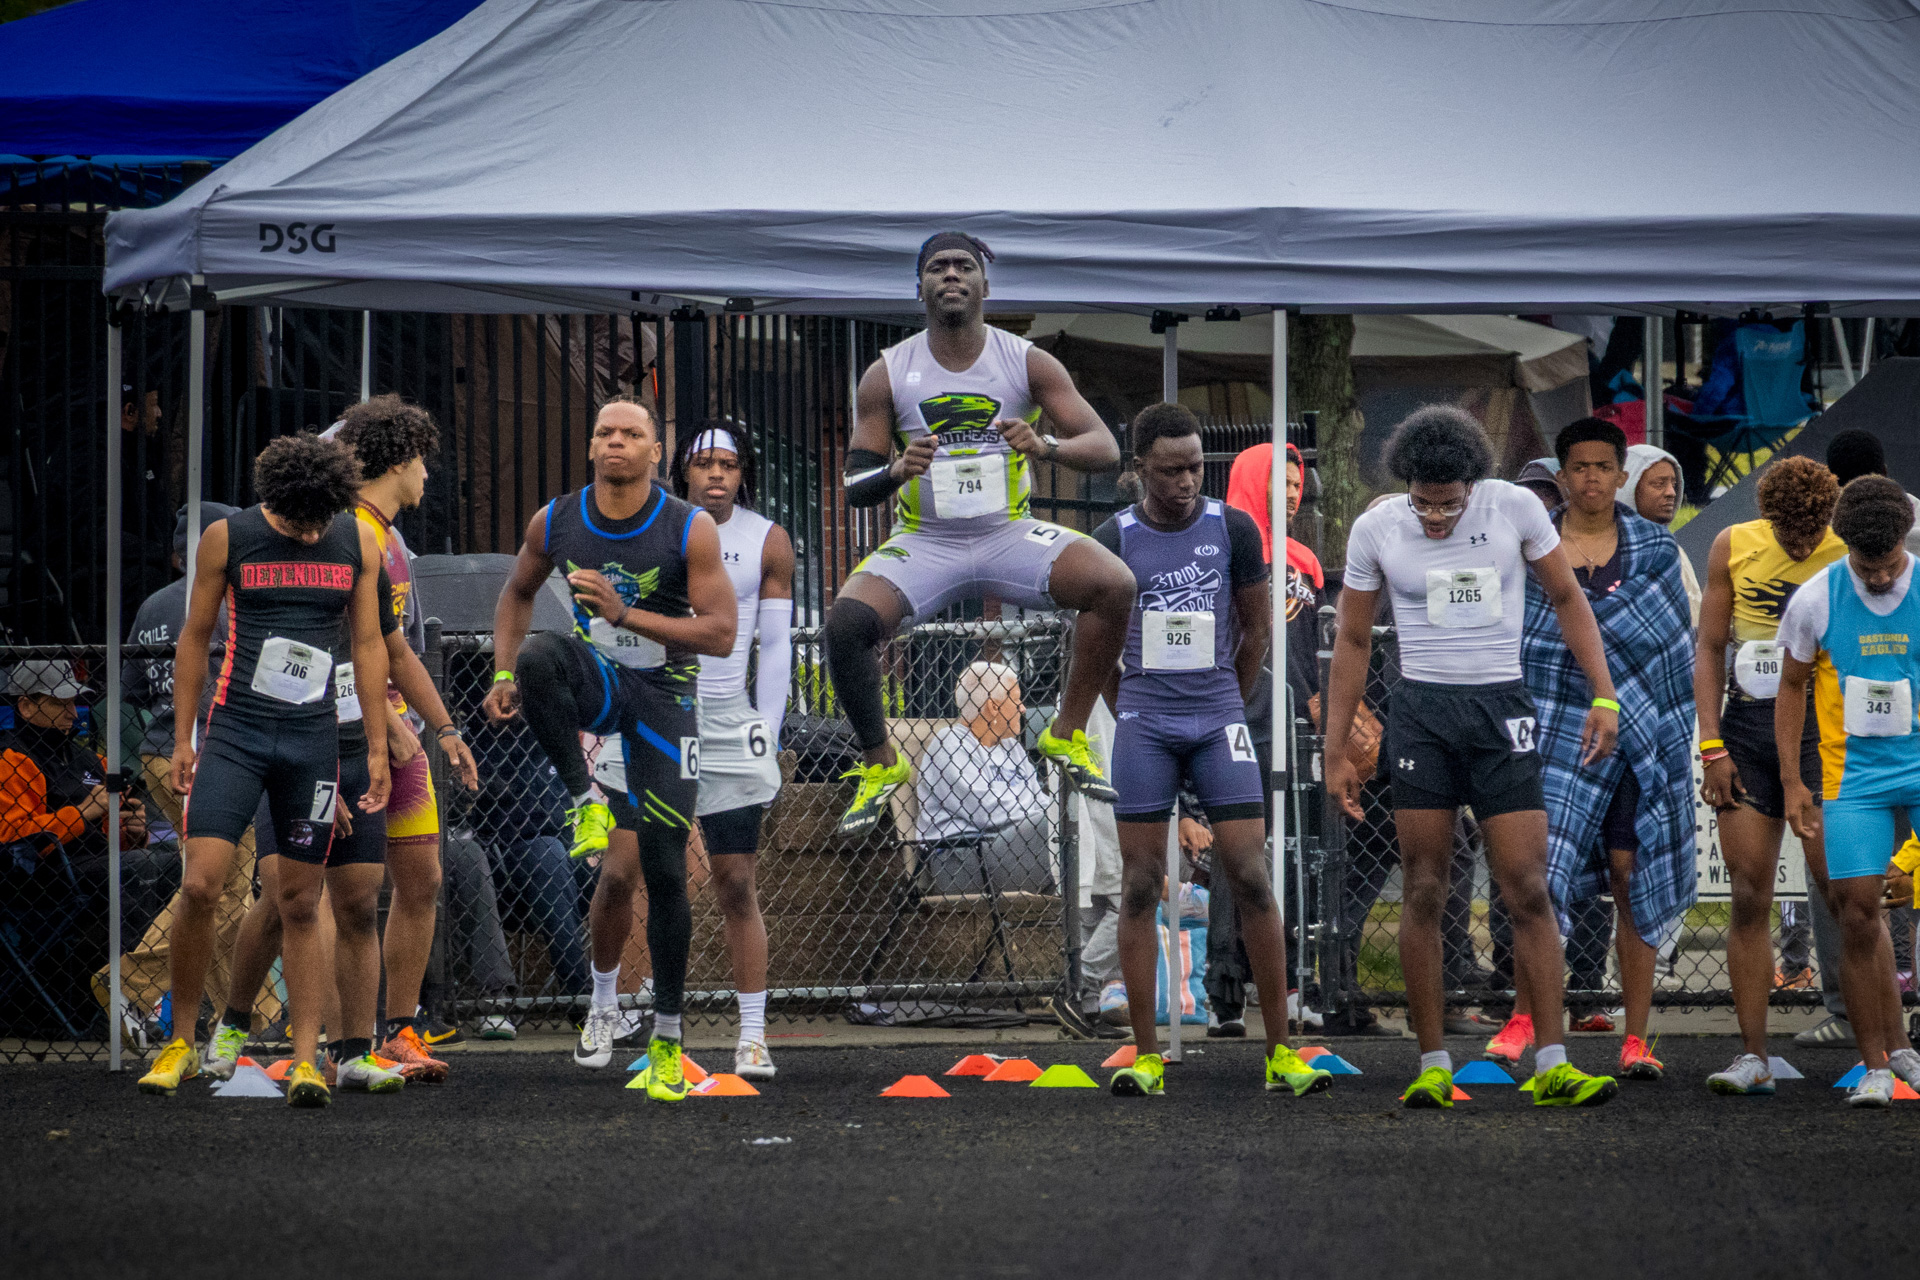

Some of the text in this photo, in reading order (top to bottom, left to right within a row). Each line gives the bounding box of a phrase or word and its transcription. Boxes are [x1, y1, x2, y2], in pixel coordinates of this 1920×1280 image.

[259, 221, 336, 254] DSG
[958, 479, 982, 494] 794
[1031, 525, 1060, 540] 5
[240, 561, 353, 590] DEFENDERS
[1449, 589, 1482, 604] 1265
[616, 635, 640, 647] 951
[1166, 632, 1191, 646] 926
[1861, 644, 1907, 656] EAGLES
[282, 661, 309, 679] 706
[1755, 661, 1778, 675] 400
[1866, 701, 1891, 714] 343
[749, 723, 767, 757] 6
[1234, 726, 1252, 758] 4
[687, 740, 698, 776] 6
[317, 783, 334, 819] 7
